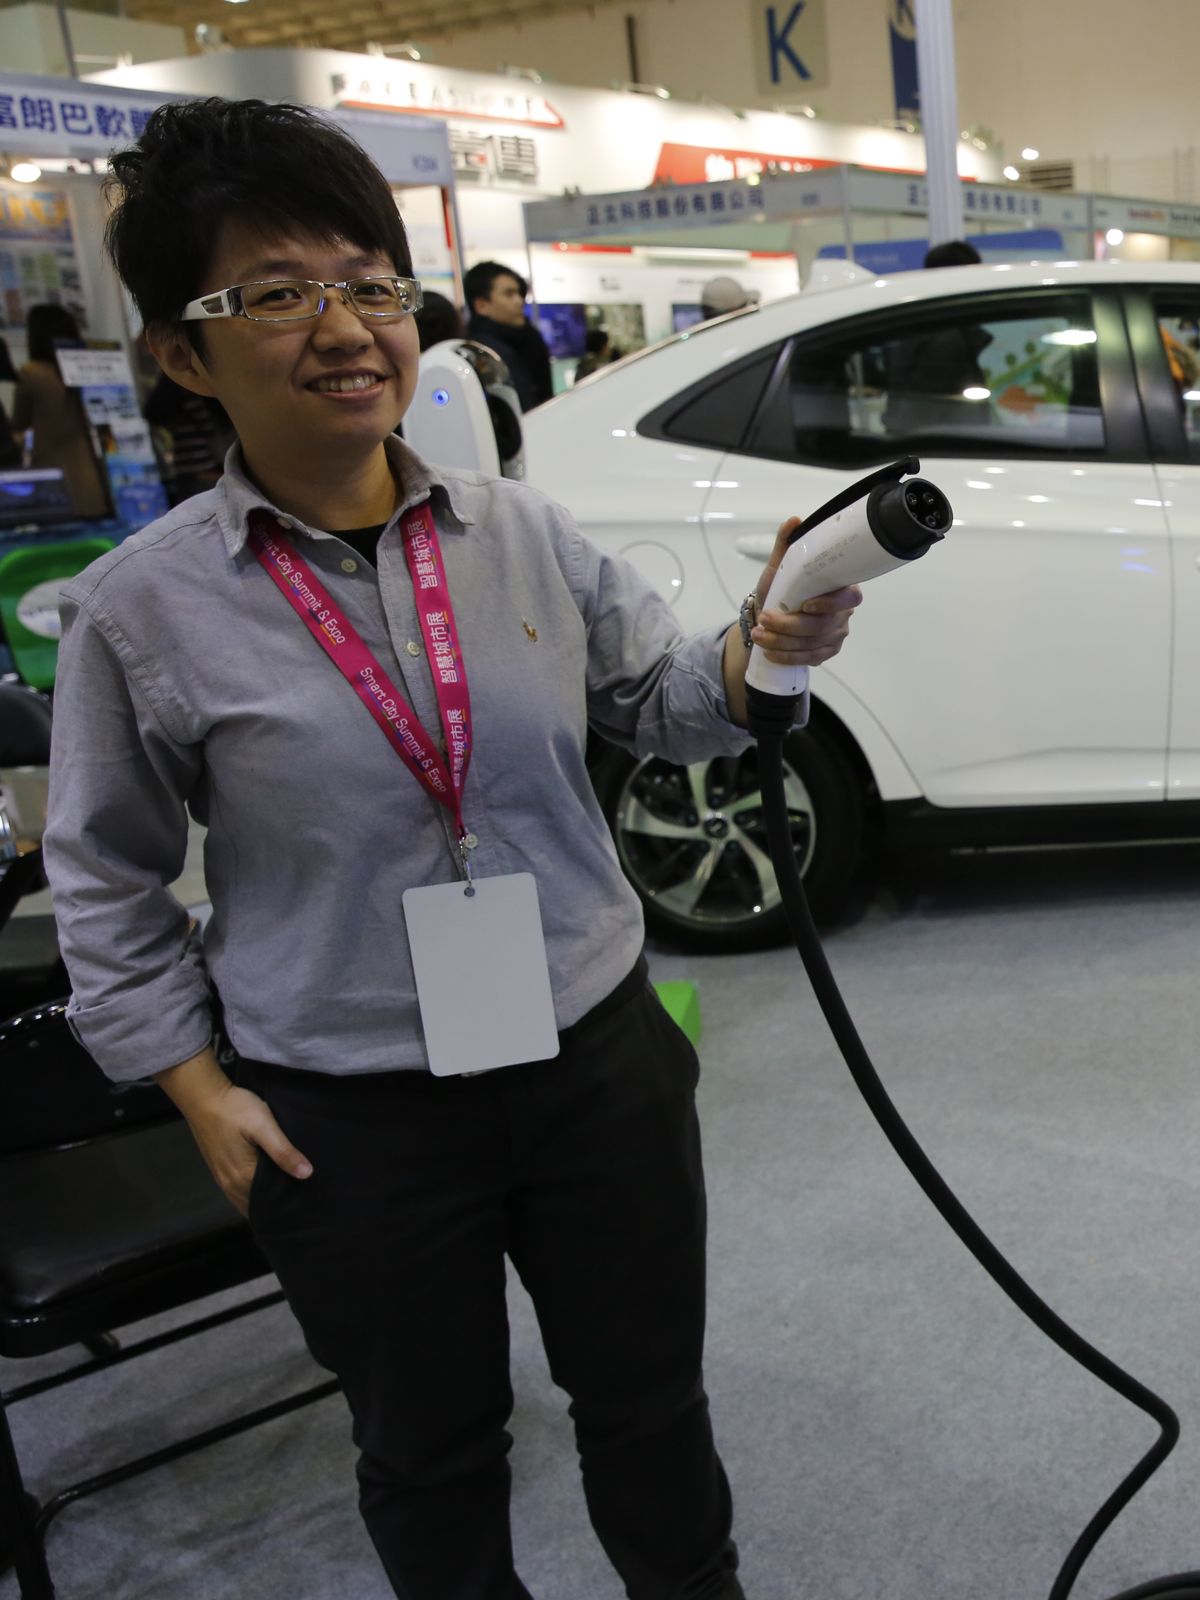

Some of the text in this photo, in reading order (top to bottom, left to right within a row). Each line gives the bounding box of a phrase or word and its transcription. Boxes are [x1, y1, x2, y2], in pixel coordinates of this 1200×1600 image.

[766, 1, 813, 85] K
[407, 519, 438, 589] 智慧城市展
[276, 553, 295, 576] City
[290, 572, 322, 612] Summit
[317, 609, 331, 621] &
[324, 619, 346, 644] Expo
[426, 611, 458, 684] 智慧城市展
[360, 667, 447, 792] Smart City Summit & Expo
